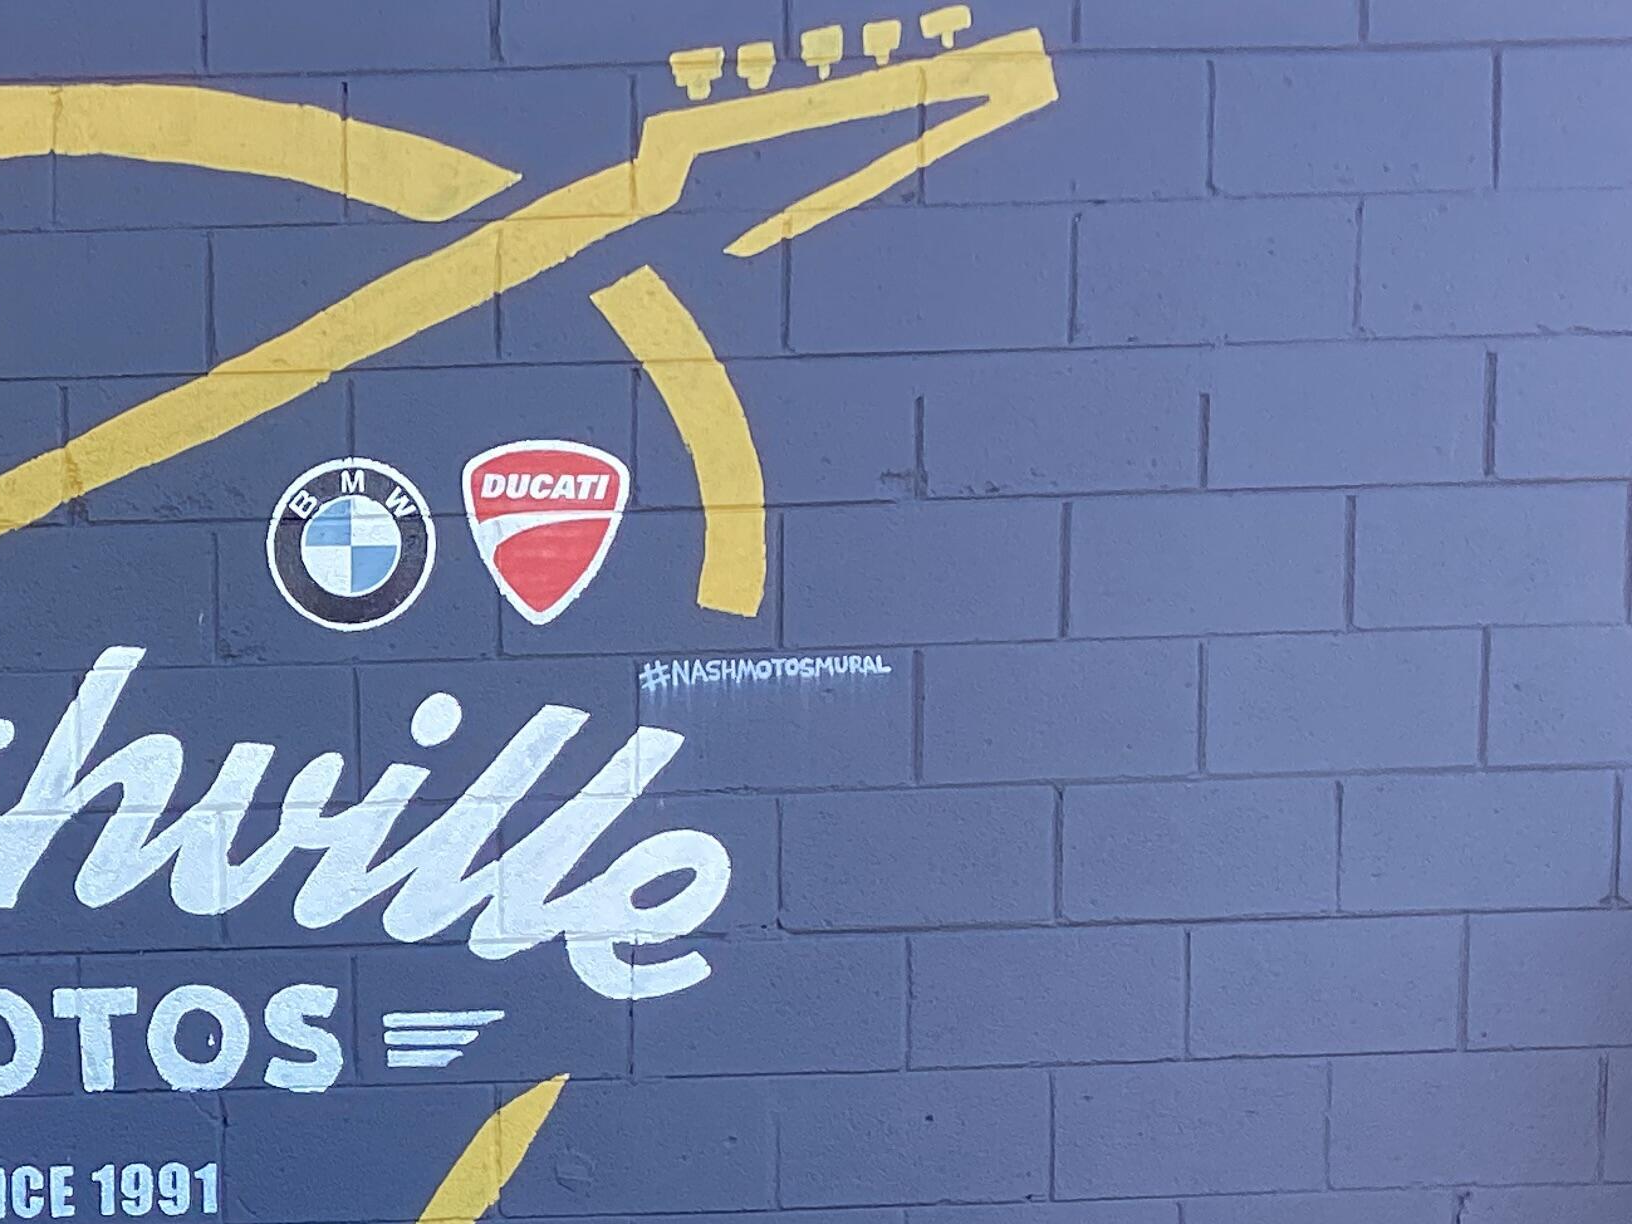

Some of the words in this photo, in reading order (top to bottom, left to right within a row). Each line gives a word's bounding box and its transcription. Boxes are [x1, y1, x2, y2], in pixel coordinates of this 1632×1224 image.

[288, 469, 417, 519] BMW
[480, 473, 611, 500] DUCATI
[639, 655, 892, 691] #NASHMOTOSMURAL
[91, 1161, 219, 1216] 1991
